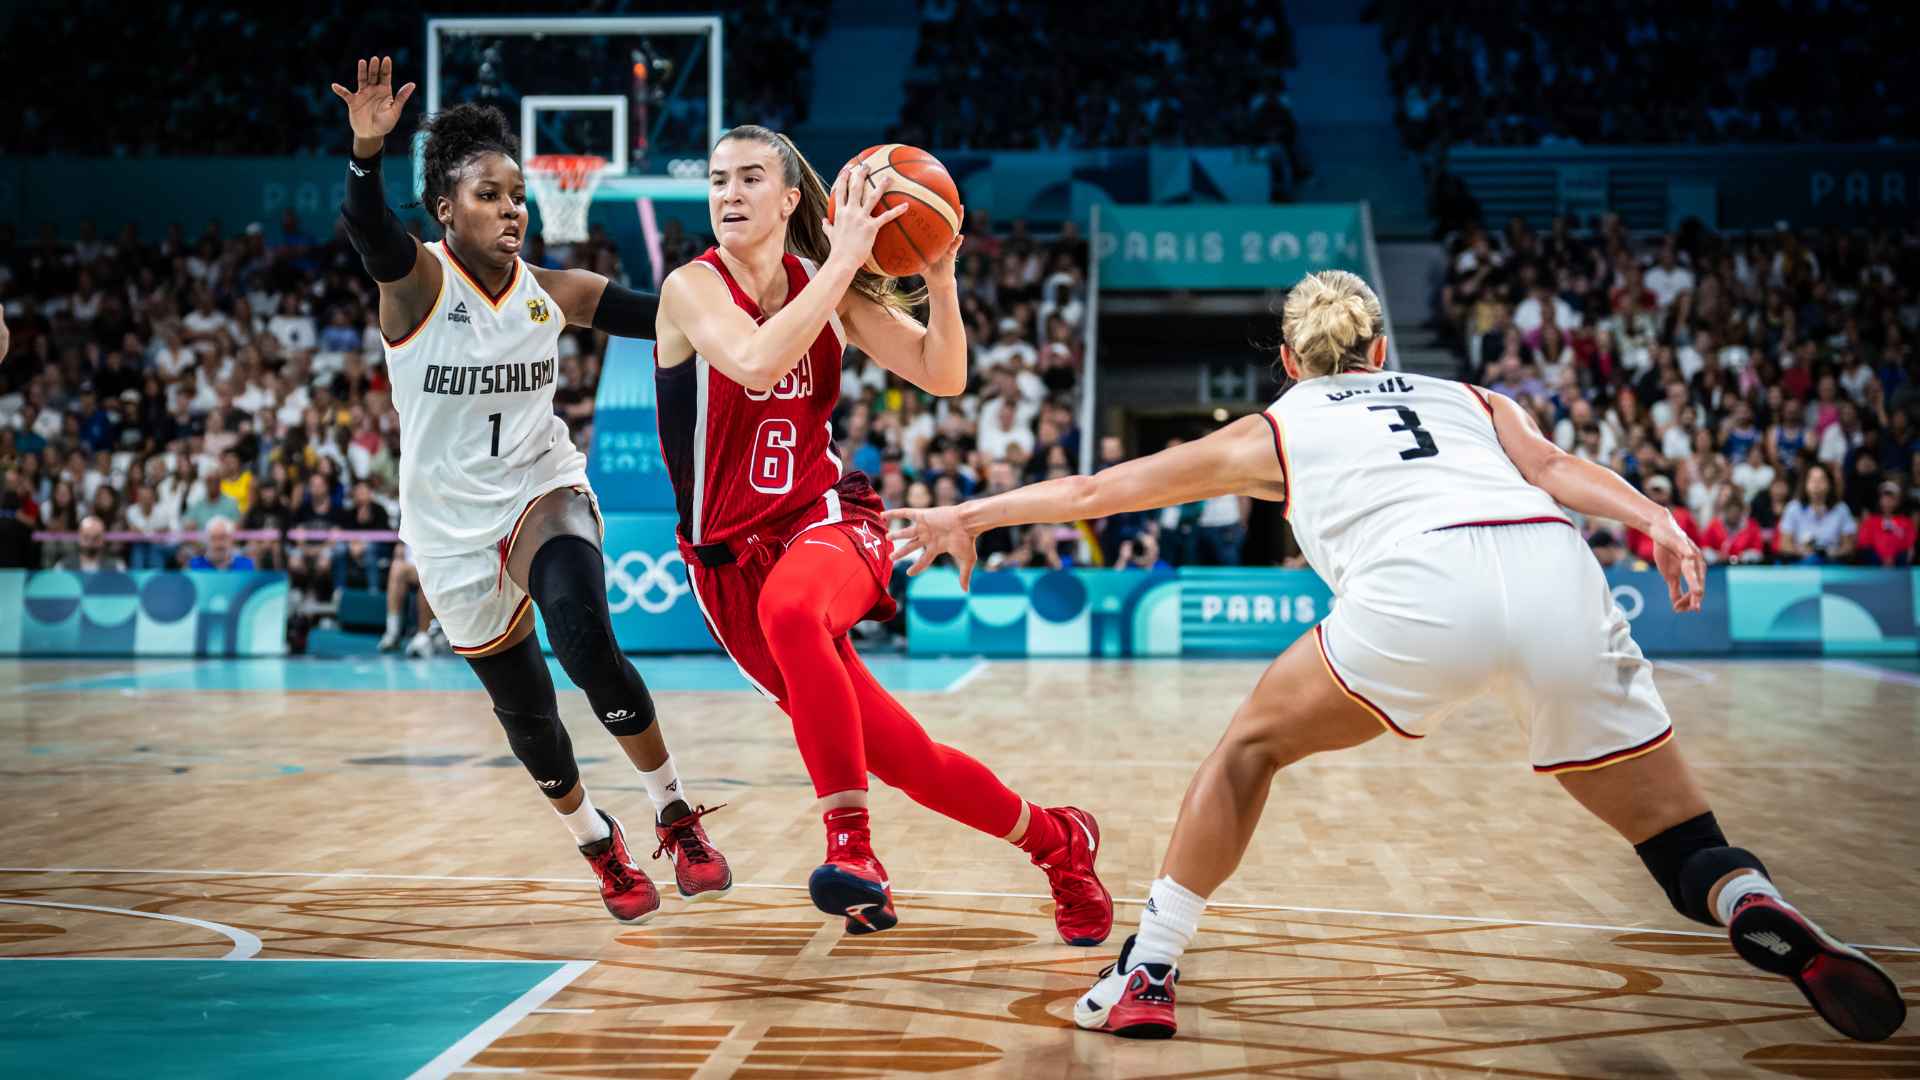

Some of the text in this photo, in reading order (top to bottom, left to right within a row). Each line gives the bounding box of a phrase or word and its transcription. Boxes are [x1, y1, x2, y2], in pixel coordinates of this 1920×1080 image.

[1098, 231, 1224, 263] PARIS
[448, 313, 472, 324] PEAK
[488, 413, 502, 457] 1
[1367, 405, 1439, 460] 3
[749, 418, 797, 494] 6
[1201, 595, 1316, 624] PARIS
